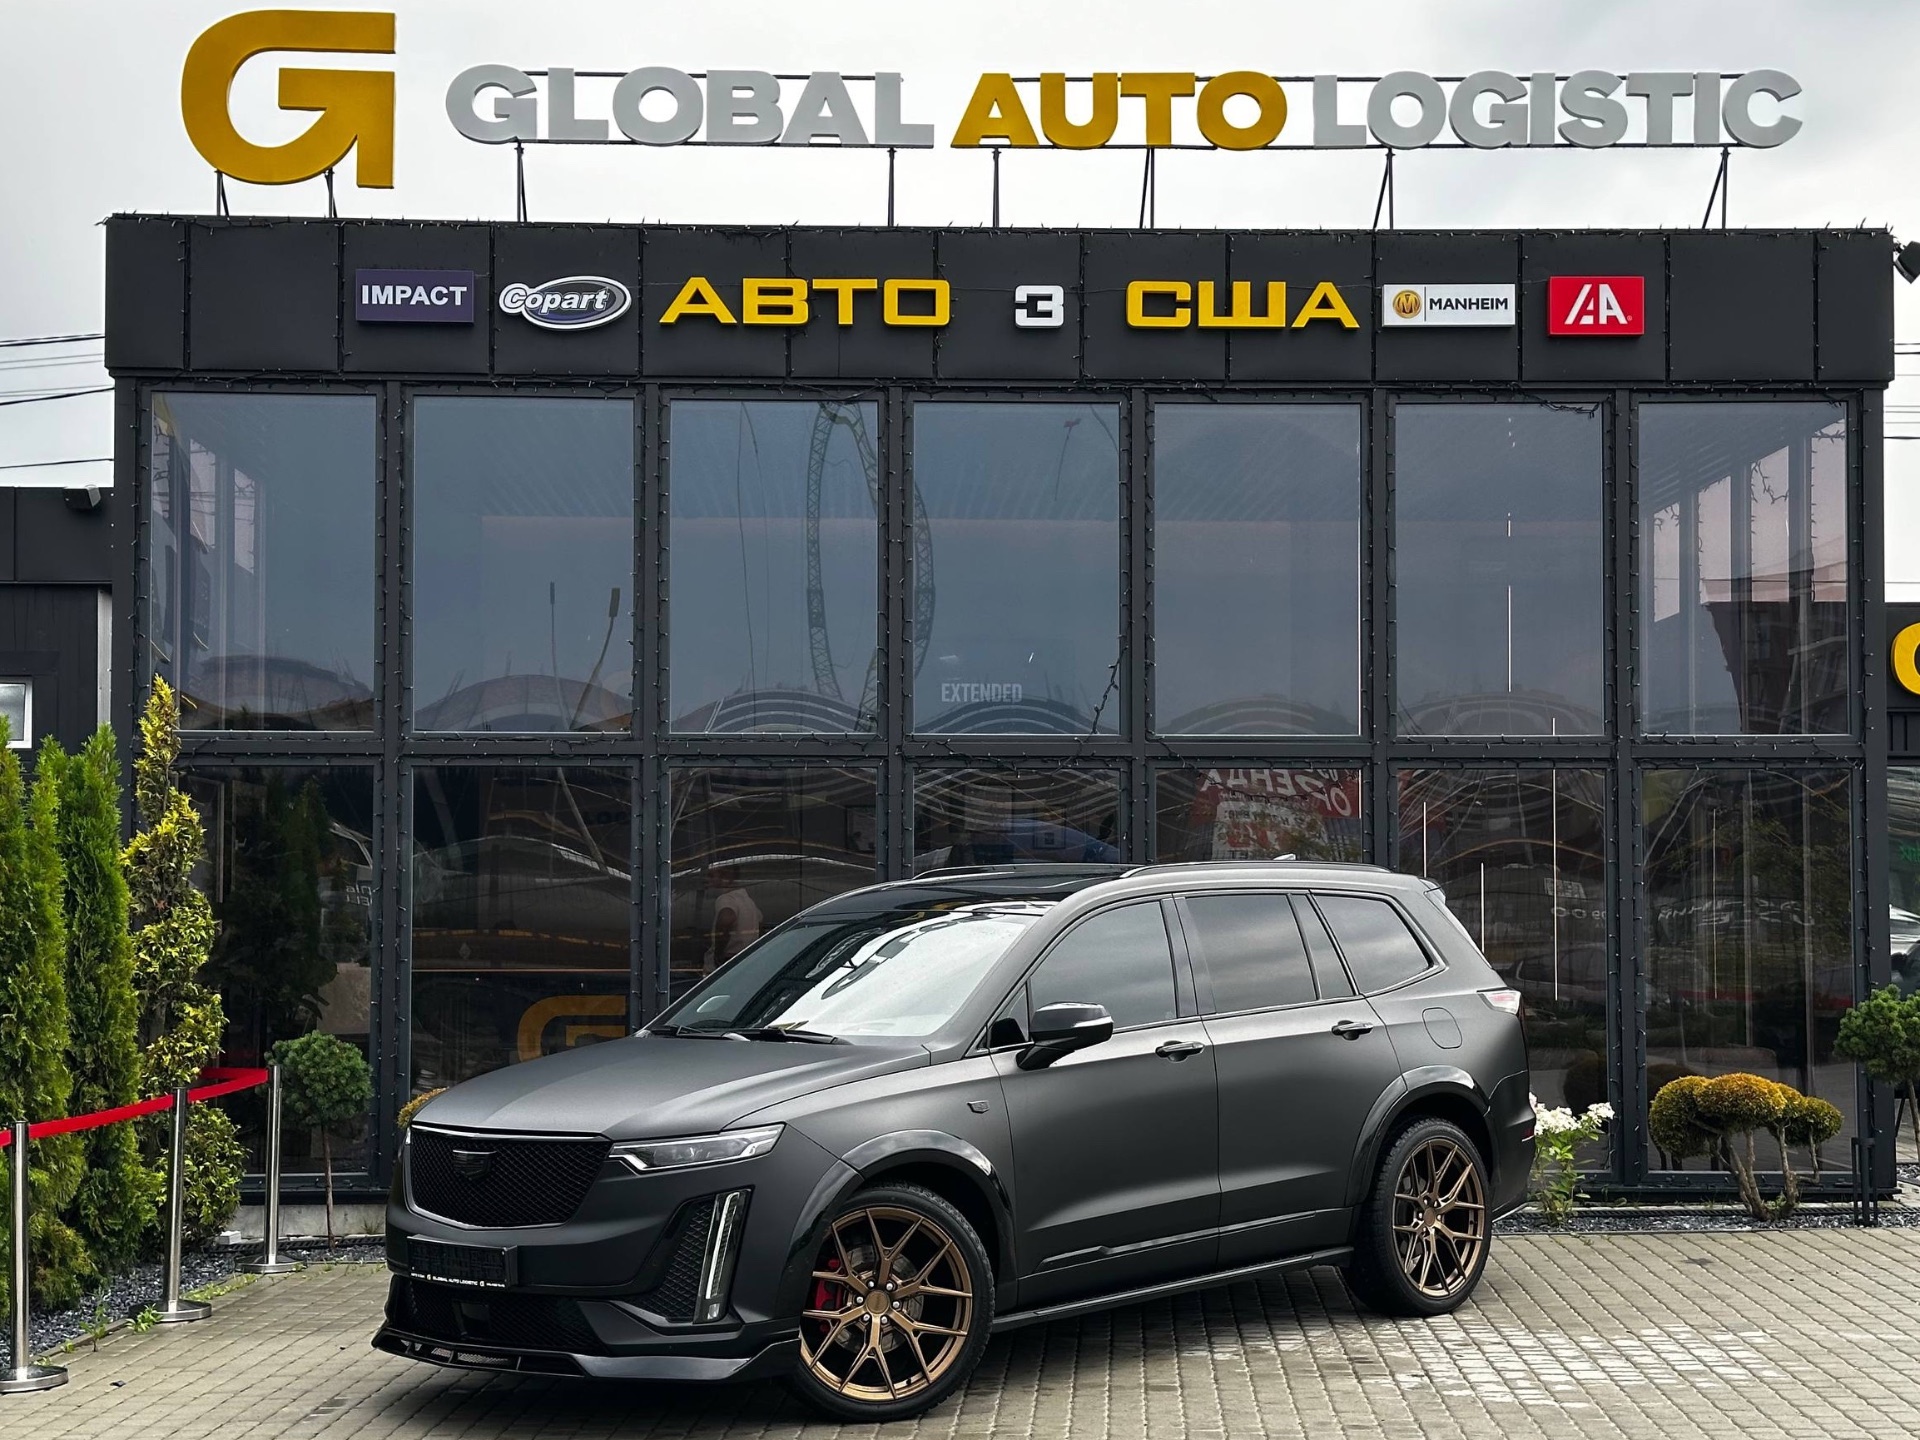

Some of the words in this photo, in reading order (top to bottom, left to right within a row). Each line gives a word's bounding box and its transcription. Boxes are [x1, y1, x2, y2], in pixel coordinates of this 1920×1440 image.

[446, 63, 935, 147] GLOBAL
[952, 71, 1287, 150] AUTO
[1313, 69, 1803, 150] LOGISTIC
[361, 284, 467, 306] IMPACT
[502, 287, 610, 315] Copart
[659, 276, 951, 327] АВТО
[1126, 280, 1360, 329] США
[1429, 298, 1508, 310] MANHEIM
[941, 683, 1022, 703] EXTENDED
